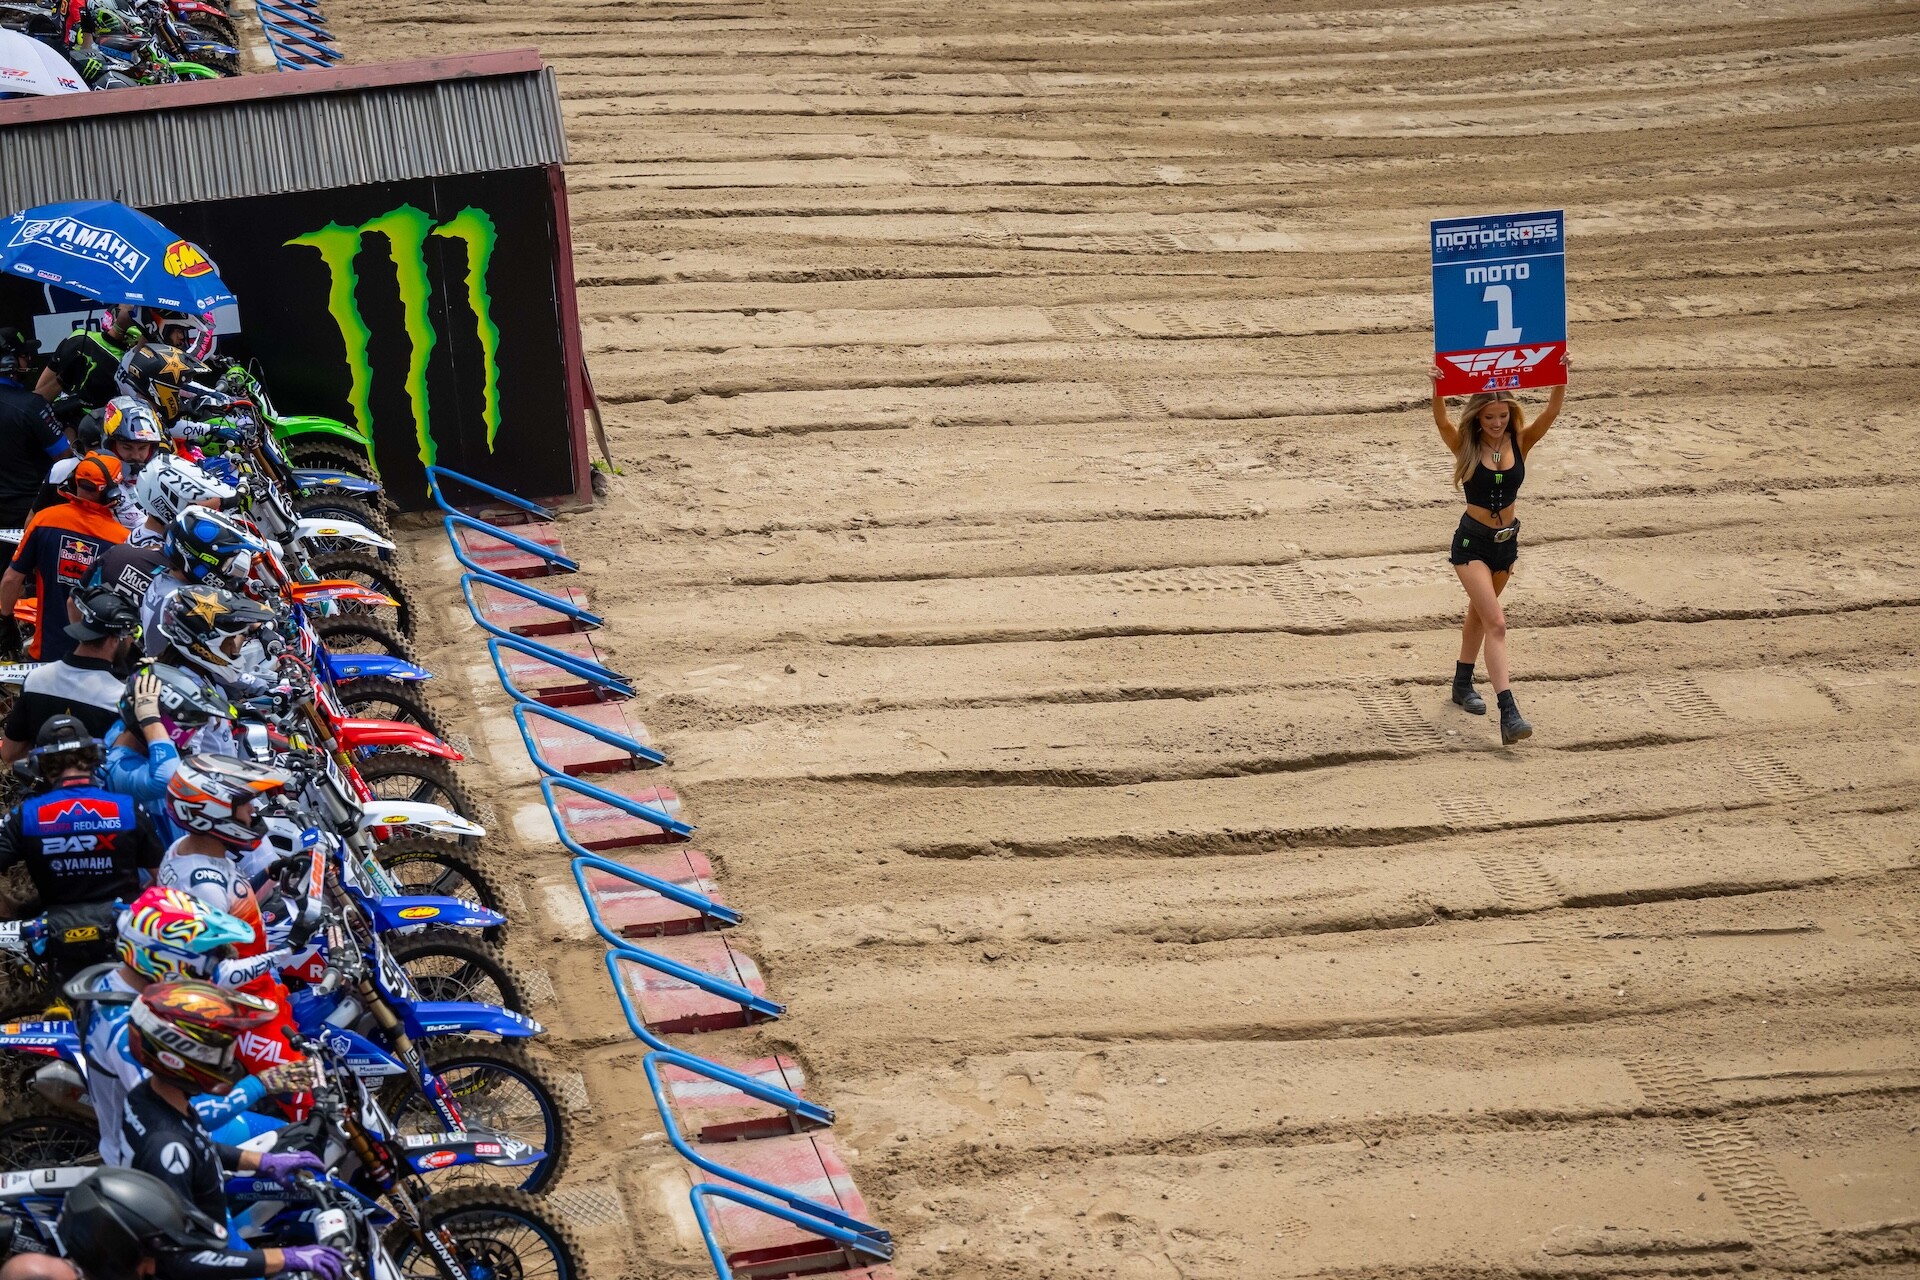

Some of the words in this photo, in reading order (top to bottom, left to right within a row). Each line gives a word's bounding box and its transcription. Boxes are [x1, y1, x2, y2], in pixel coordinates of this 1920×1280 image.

[1480, 221, 1513, 230] PRO
[1436, 223, 1557, 248] MOTOCROSS
[46, 219, 140, 271] YAMAHA
[1436, 237, 1558, 253] CHAMPIONSHIP
[23, 236, 126, 272] RACING
[1465, 263, 1530, 284] MOTO
[158, 298, 180, 307] THOR
[1482, 284, 1523, 347] 1
[1444, 346, 1557, 372] FLY
[1468, 366, 1534, 377] RACING
[158, 468, 206, 500] FXR
[61, 549, 78, 560] Red
[58, 741, 81, 751] DAVIS
[73, 819, 121, 831] REDLANDS
[42, 833, 117, 856] BARX
[64, 857, 113, 871] YAMAHA
[0, 1037, 58, 1045] DUNLOP
[161, 1053, 181, 1068] BELL
[435, 1098, 461, 1134] DUNLO
[476, 1144, 500, 1154] SBB
